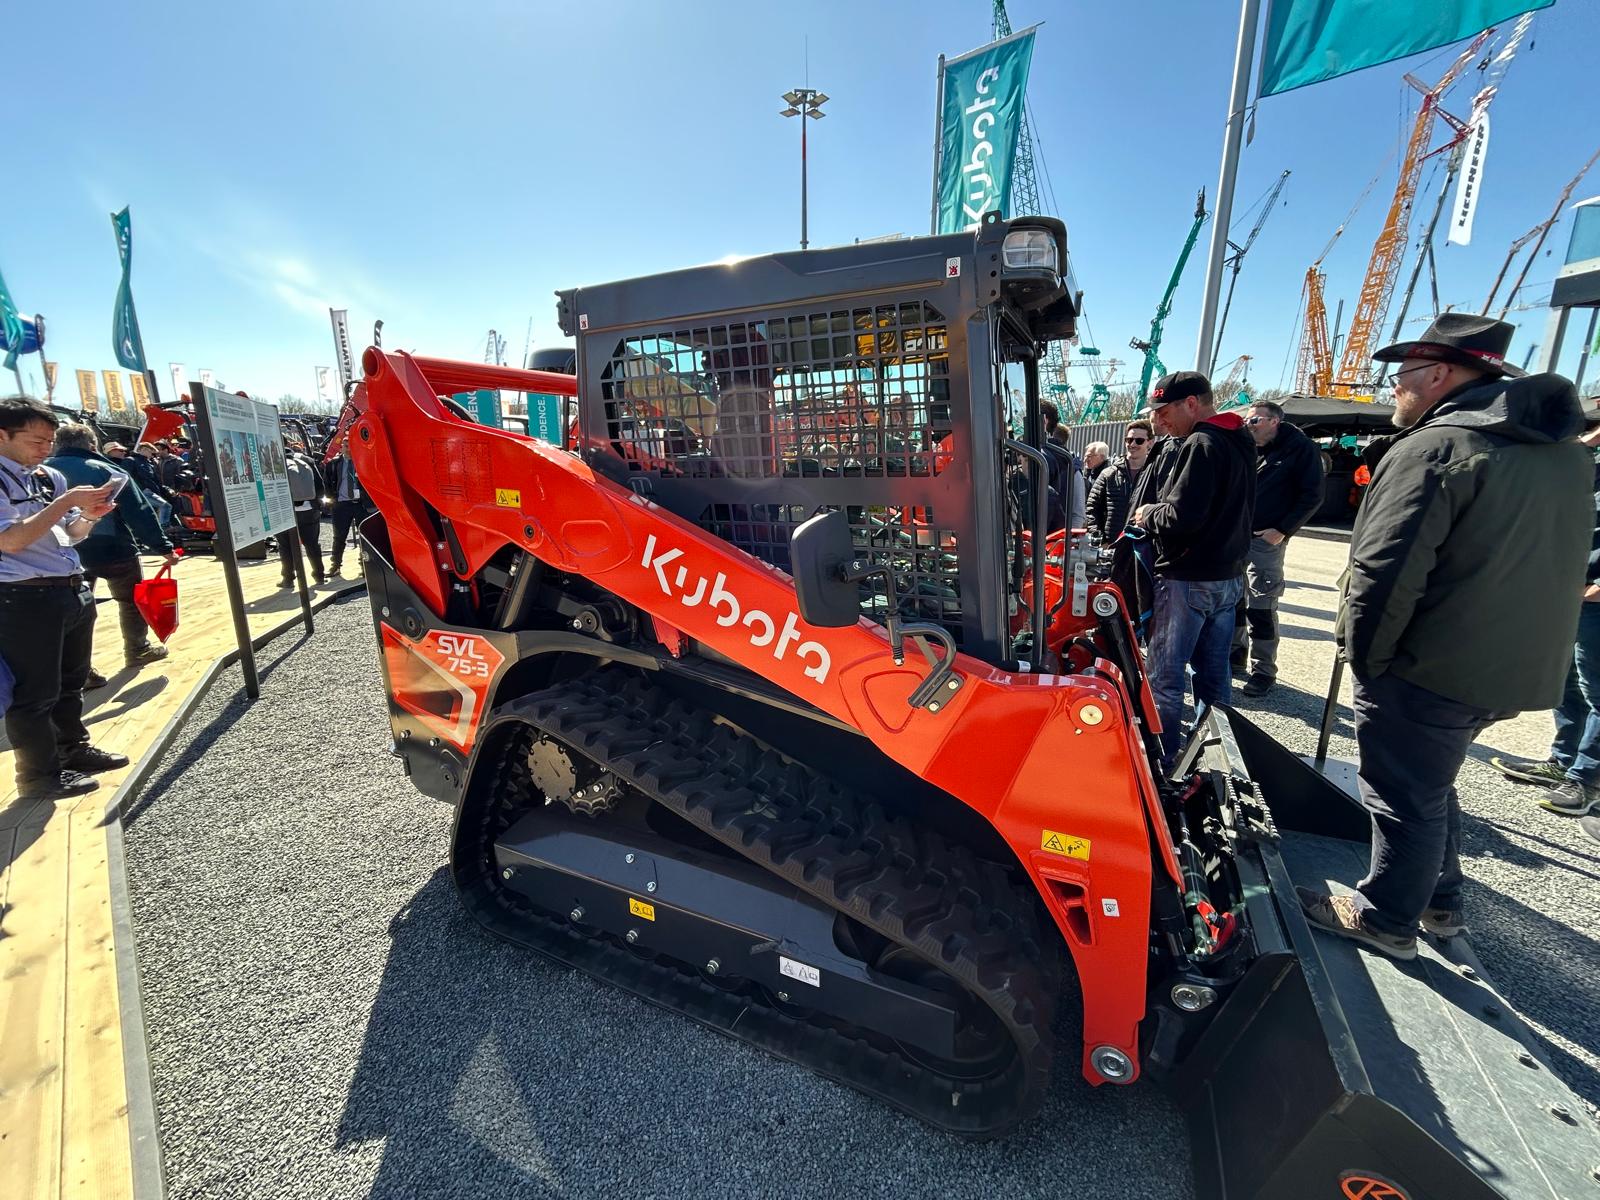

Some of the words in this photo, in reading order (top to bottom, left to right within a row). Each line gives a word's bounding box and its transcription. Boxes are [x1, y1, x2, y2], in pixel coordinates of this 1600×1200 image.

[641, 534, 831, 684] Kubota
[437, 635, 484, 660] SVL
[447, 656, 489, 678] 75-3
